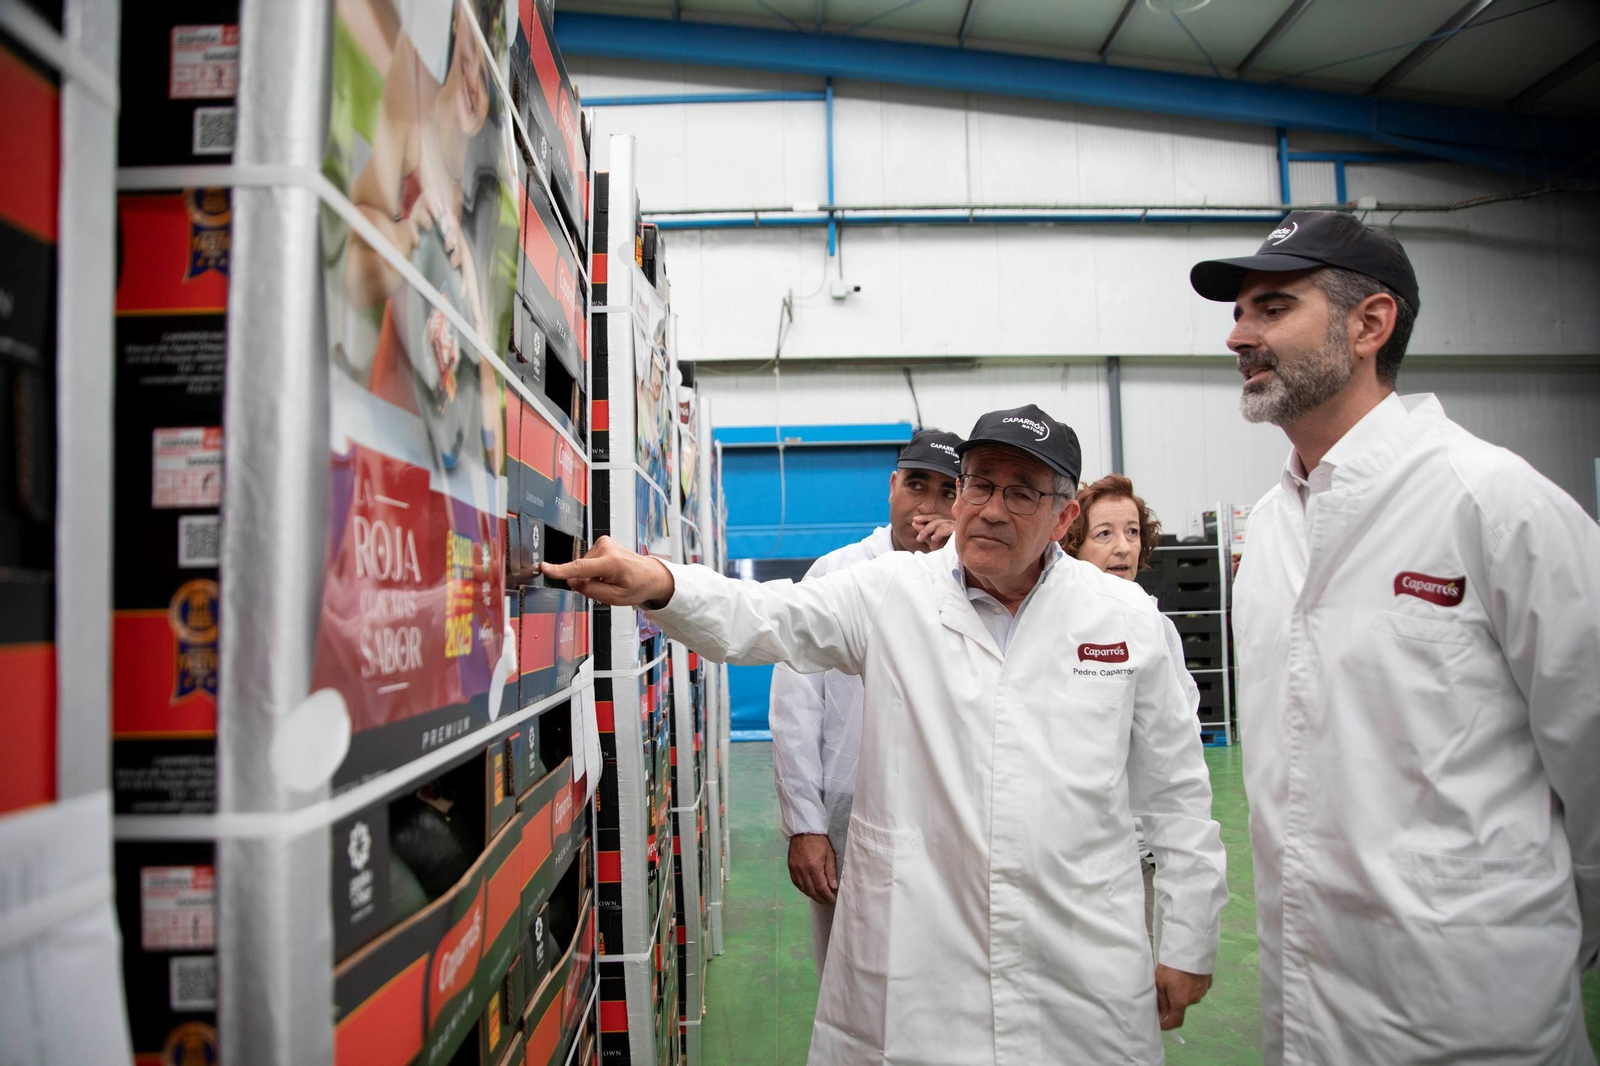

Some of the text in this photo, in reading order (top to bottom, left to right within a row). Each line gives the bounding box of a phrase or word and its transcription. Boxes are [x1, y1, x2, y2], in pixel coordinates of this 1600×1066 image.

[930, 442, 955, 452] CAPARR
[353, 515, 422, 583] ROJA
[360, 626, 424, 679] SABOR
[1073, 667, 1097, 676] Pedro
[422, 715, 471, 750] PREMIUM
